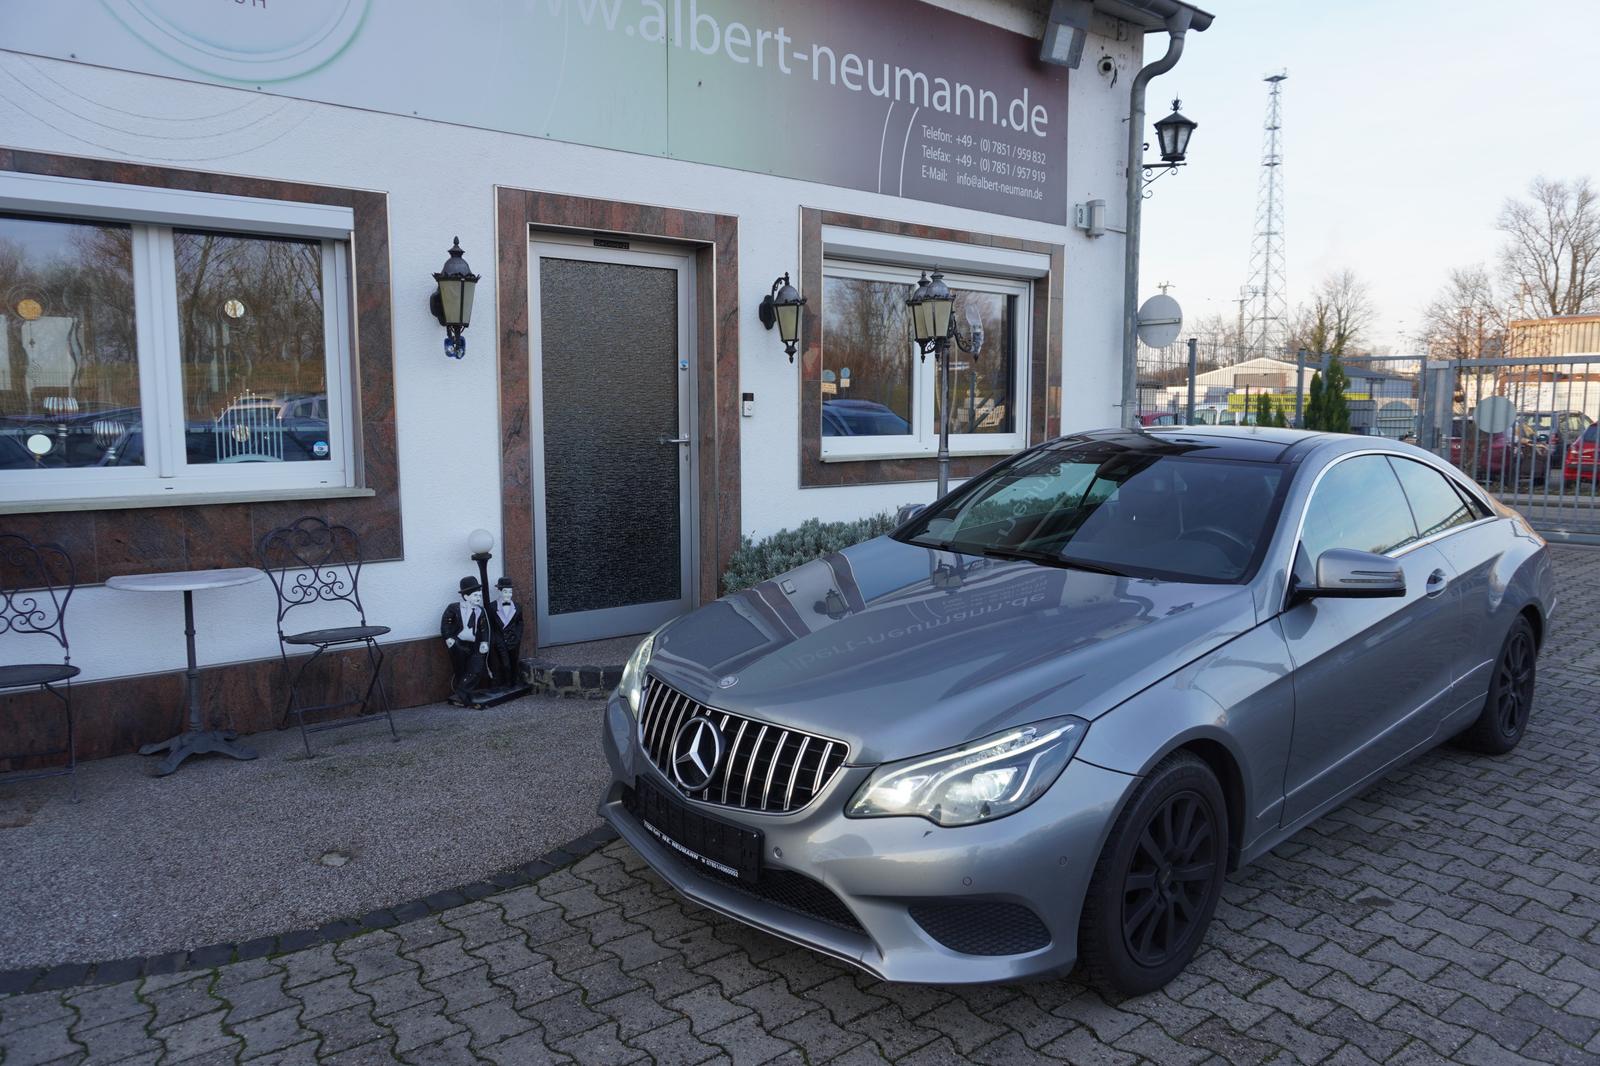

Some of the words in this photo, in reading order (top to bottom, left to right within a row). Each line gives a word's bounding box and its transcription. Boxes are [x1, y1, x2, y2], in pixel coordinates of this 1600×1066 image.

[921, 124, 952, 144] Telefon:
[980, 137, 990, 153] (0)
[992, 141, 1010, 157] 7851
[1017, 147, 1031, 161] 959
[1032, 150, 1046, 165] 832
[921, 145, 951, 163] Telefax:
[979, 157, 990, 173] (0)
[991, 160, 1010, 175] 7851
[1017, 166, 1031, 180] 957
[1032, 169, 1046, 183] 919
[921, 165, 948, 182] E-Mail:
[956, 171, 1043, 200] info@albert-neumann.de
